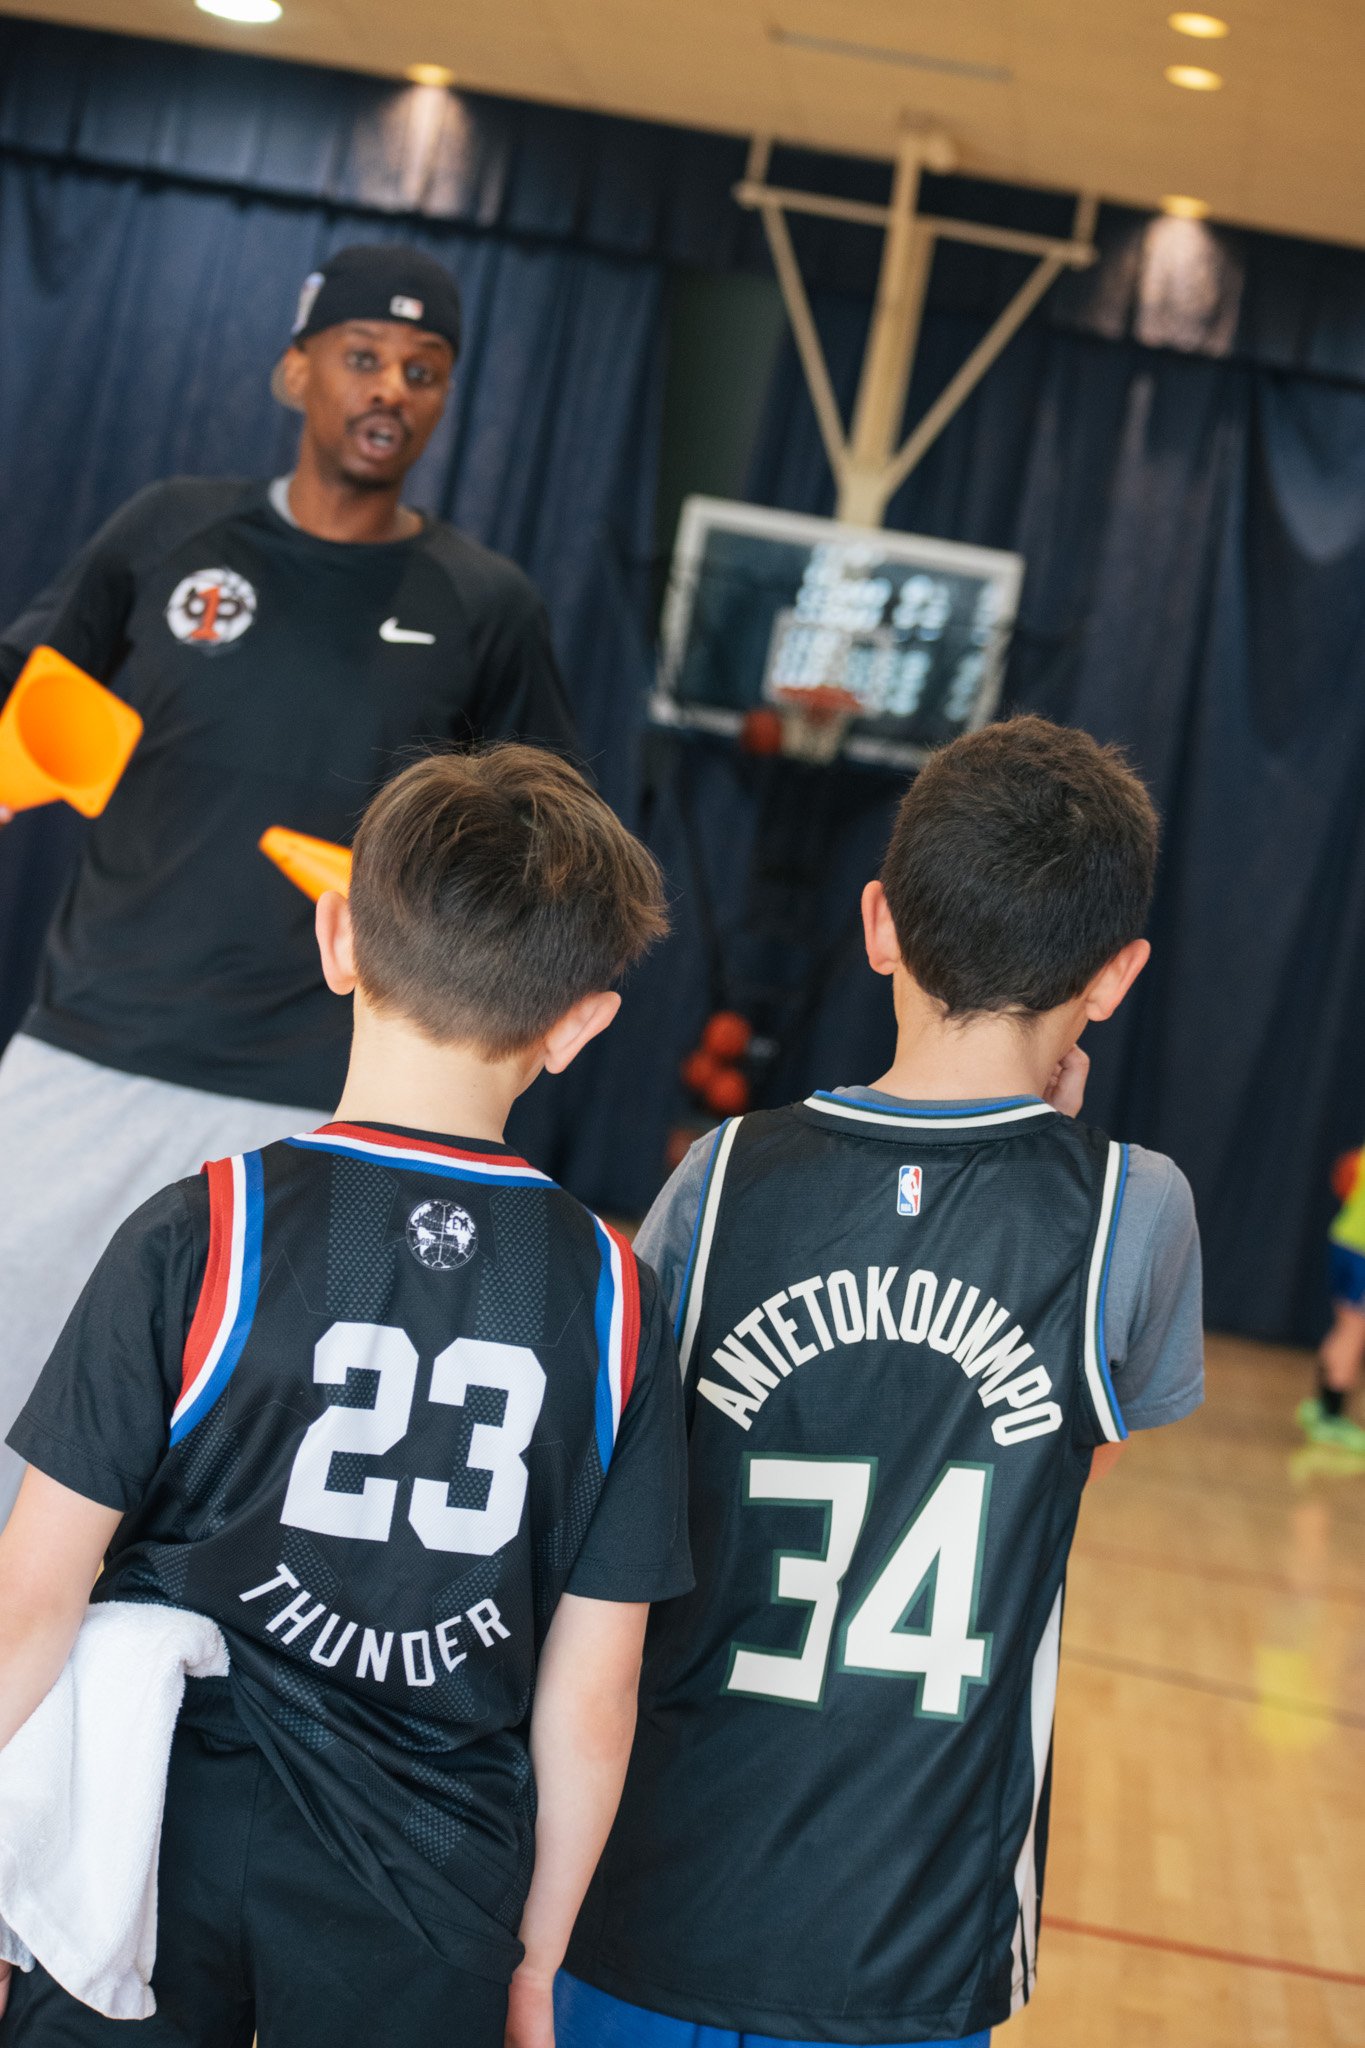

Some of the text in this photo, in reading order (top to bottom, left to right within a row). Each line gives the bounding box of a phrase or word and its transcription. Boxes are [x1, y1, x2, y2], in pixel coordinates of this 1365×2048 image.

[279, 1320, 548, 1558] 23
[696, 1265, 1064, 1447] ANTETOKOUNMPO
[238, 1563, 512, 1687] THUNDER
[720, 1451, 994, 1723] 34
